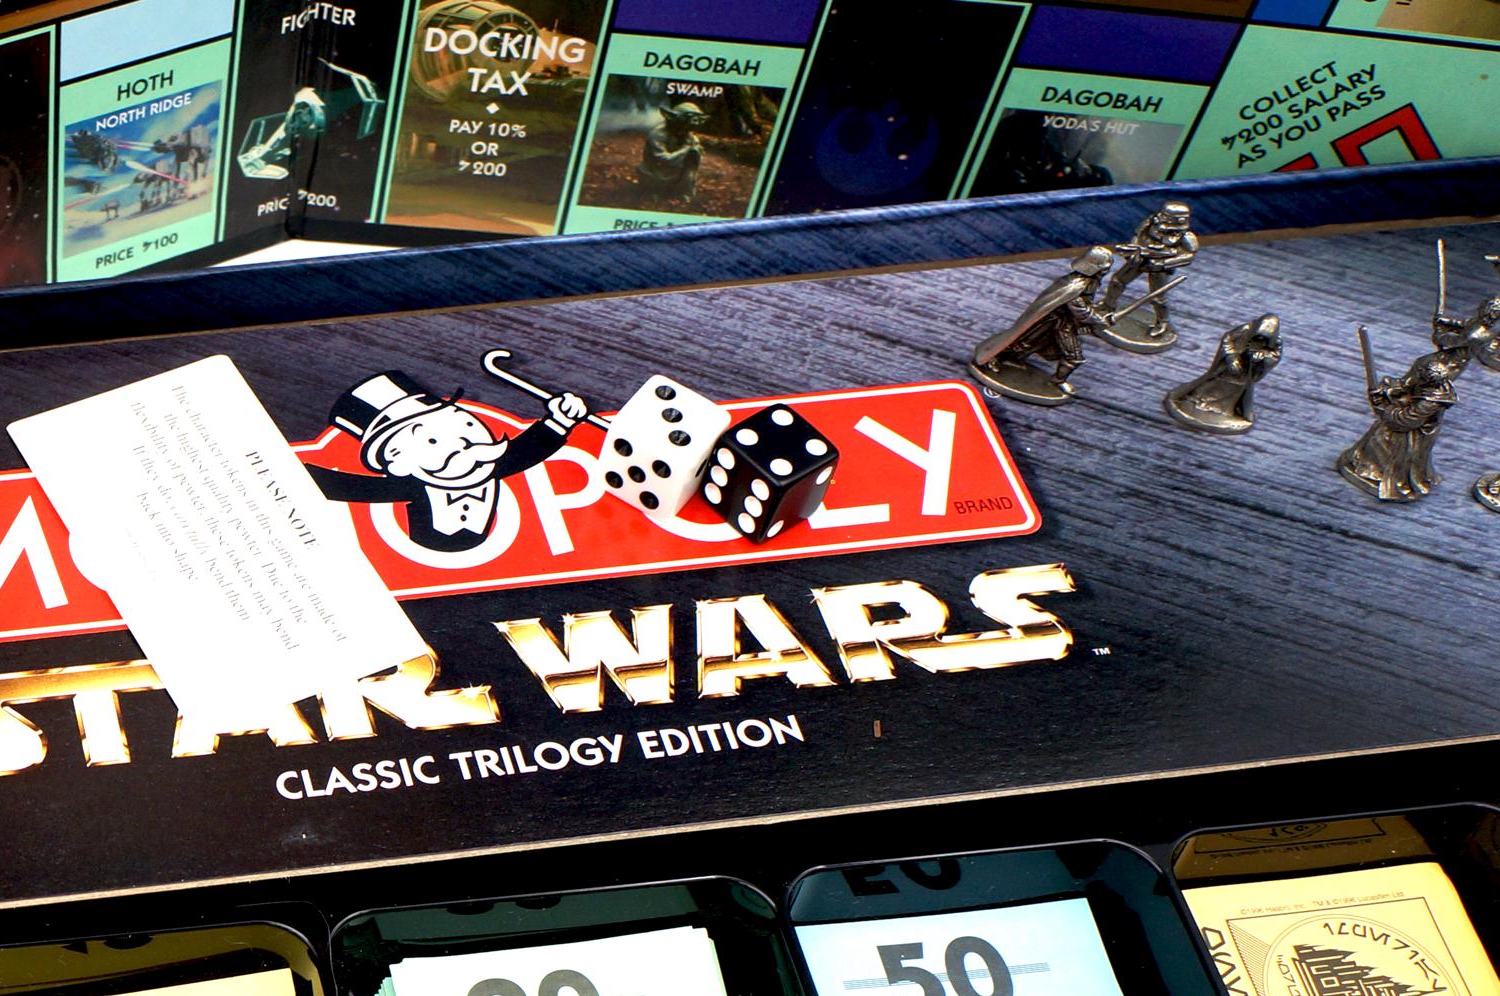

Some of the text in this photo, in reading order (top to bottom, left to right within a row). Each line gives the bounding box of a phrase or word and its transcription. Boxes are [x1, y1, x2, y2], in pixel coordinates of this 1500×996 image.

[281, 2, 356, 35] FIGHTER
[424, 27, 587, 64] DOCKING
[643, 51, 761, 76] DAGOBAH
[117, 69, 174, 101] HOTH
[467, 67, 531, 96] TAX
[665, 81, 724, 98] SWAMP
[1239, 60, 1338, 121] COLLECT
[1287, 64, 1376, 119] SALARY
[95, 92, 192, 132] NORTH RIDGE
[1040, 86, 1163, 113] DAGOBAH
[449, 119, 527, 138] PAY 10%
[1104, 120, 1140, 135] HUT
[1237, 144, 1267, 168] AS
[1269, 115, 1322, 149] YOU
[1326, 84, 1387, 122] PASS
[471, 141, 499, 156] OR
[95, 246, 134, 269] PRICE
[170, 385, 189, 406] The
[244, 450, 319, 549] PLEASE NOTE
[954, 496, 1013, 516] BRAND
[494, 562, 1078, 714] WARS
[276, 714, 805, 801] CLASSIC TRILOGY EDITION
